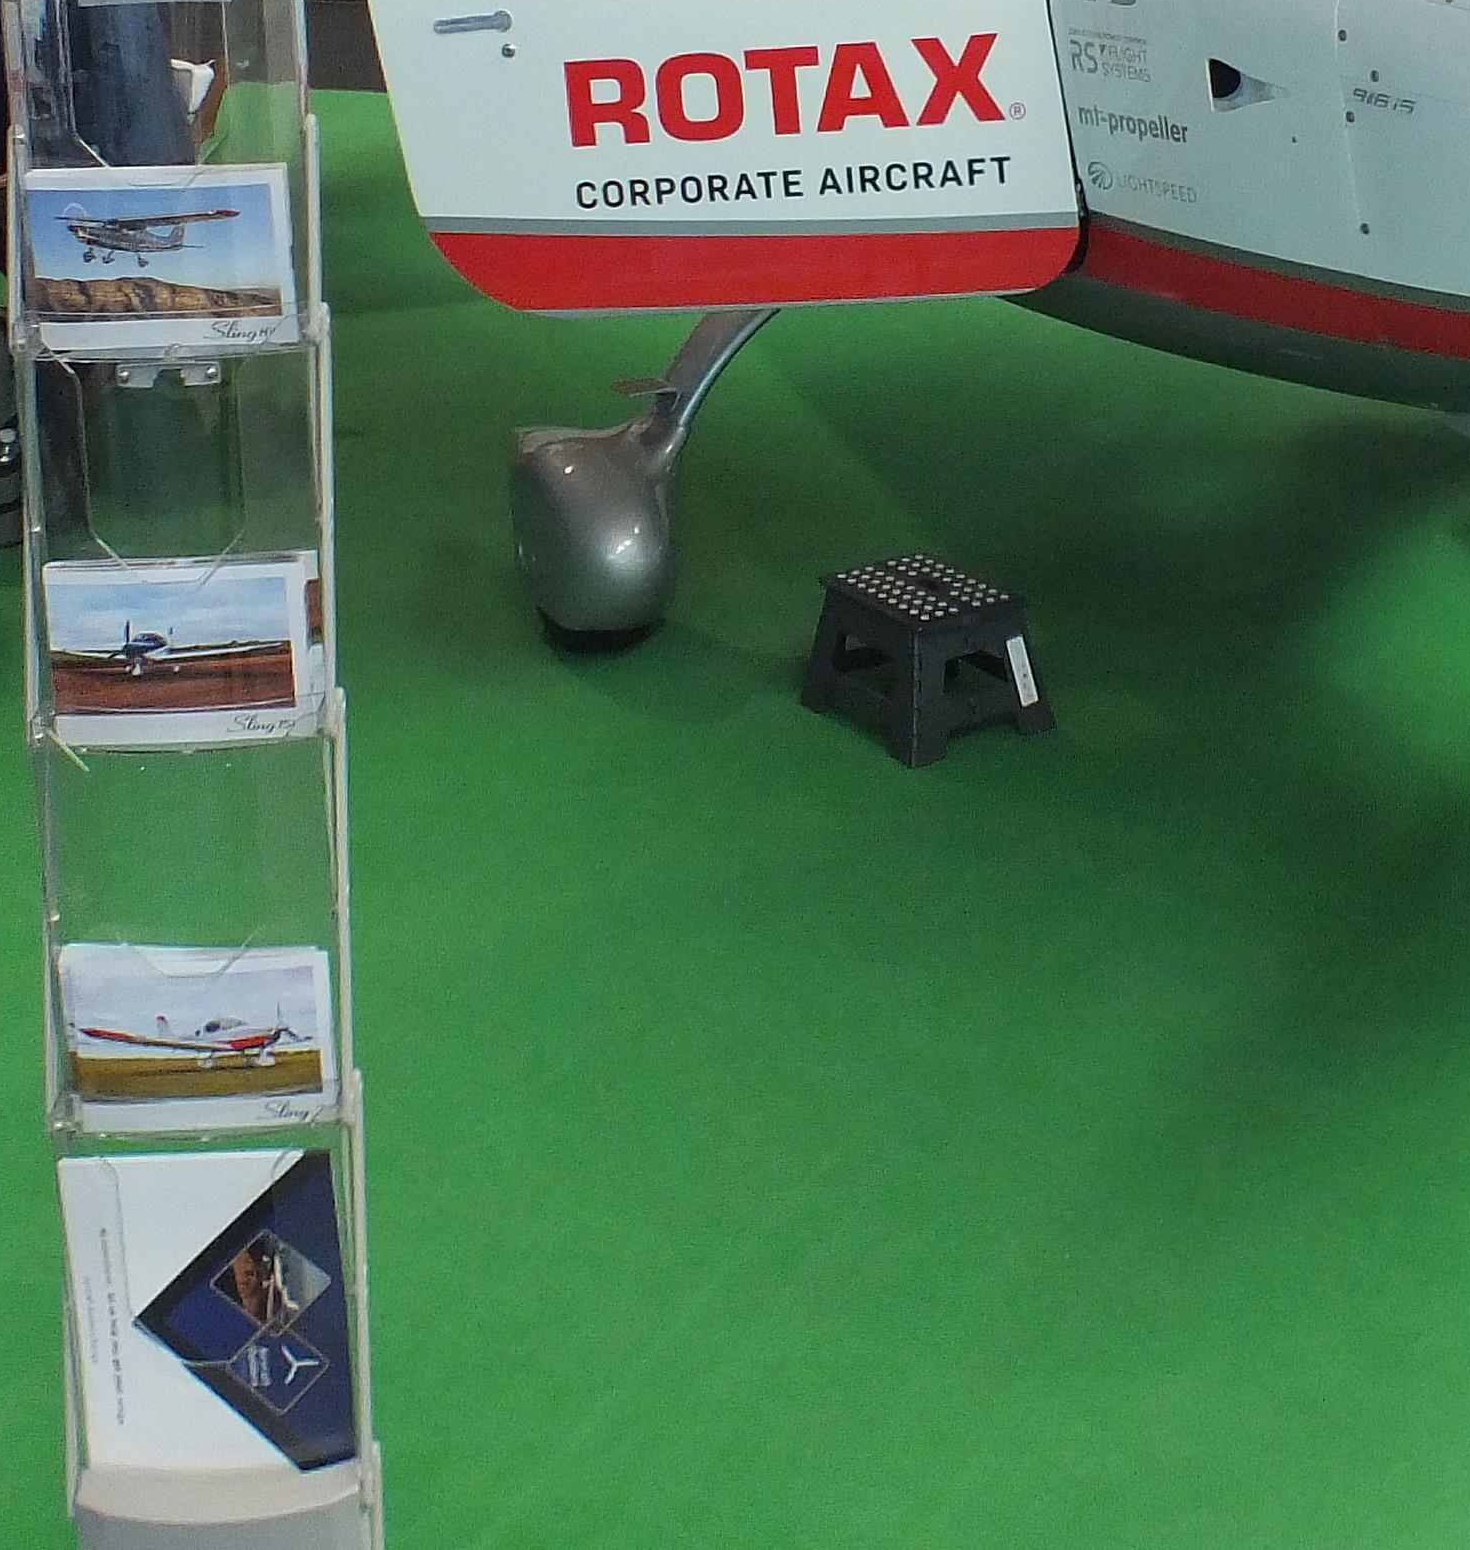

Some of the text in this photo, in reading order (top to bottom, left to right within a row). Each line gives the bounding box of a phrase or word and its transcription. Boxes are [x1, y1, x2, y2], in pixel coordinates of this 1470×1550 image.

[1070, 39, 1098, 74] RS
[563, 33, 1006, 148] ROTAX
[1078, 103, 1189, 144] mt-propeller
[575, 155, 1013, 210] CORPORATE AIRCRAFT
[203, 320, 257, 342] Sling
